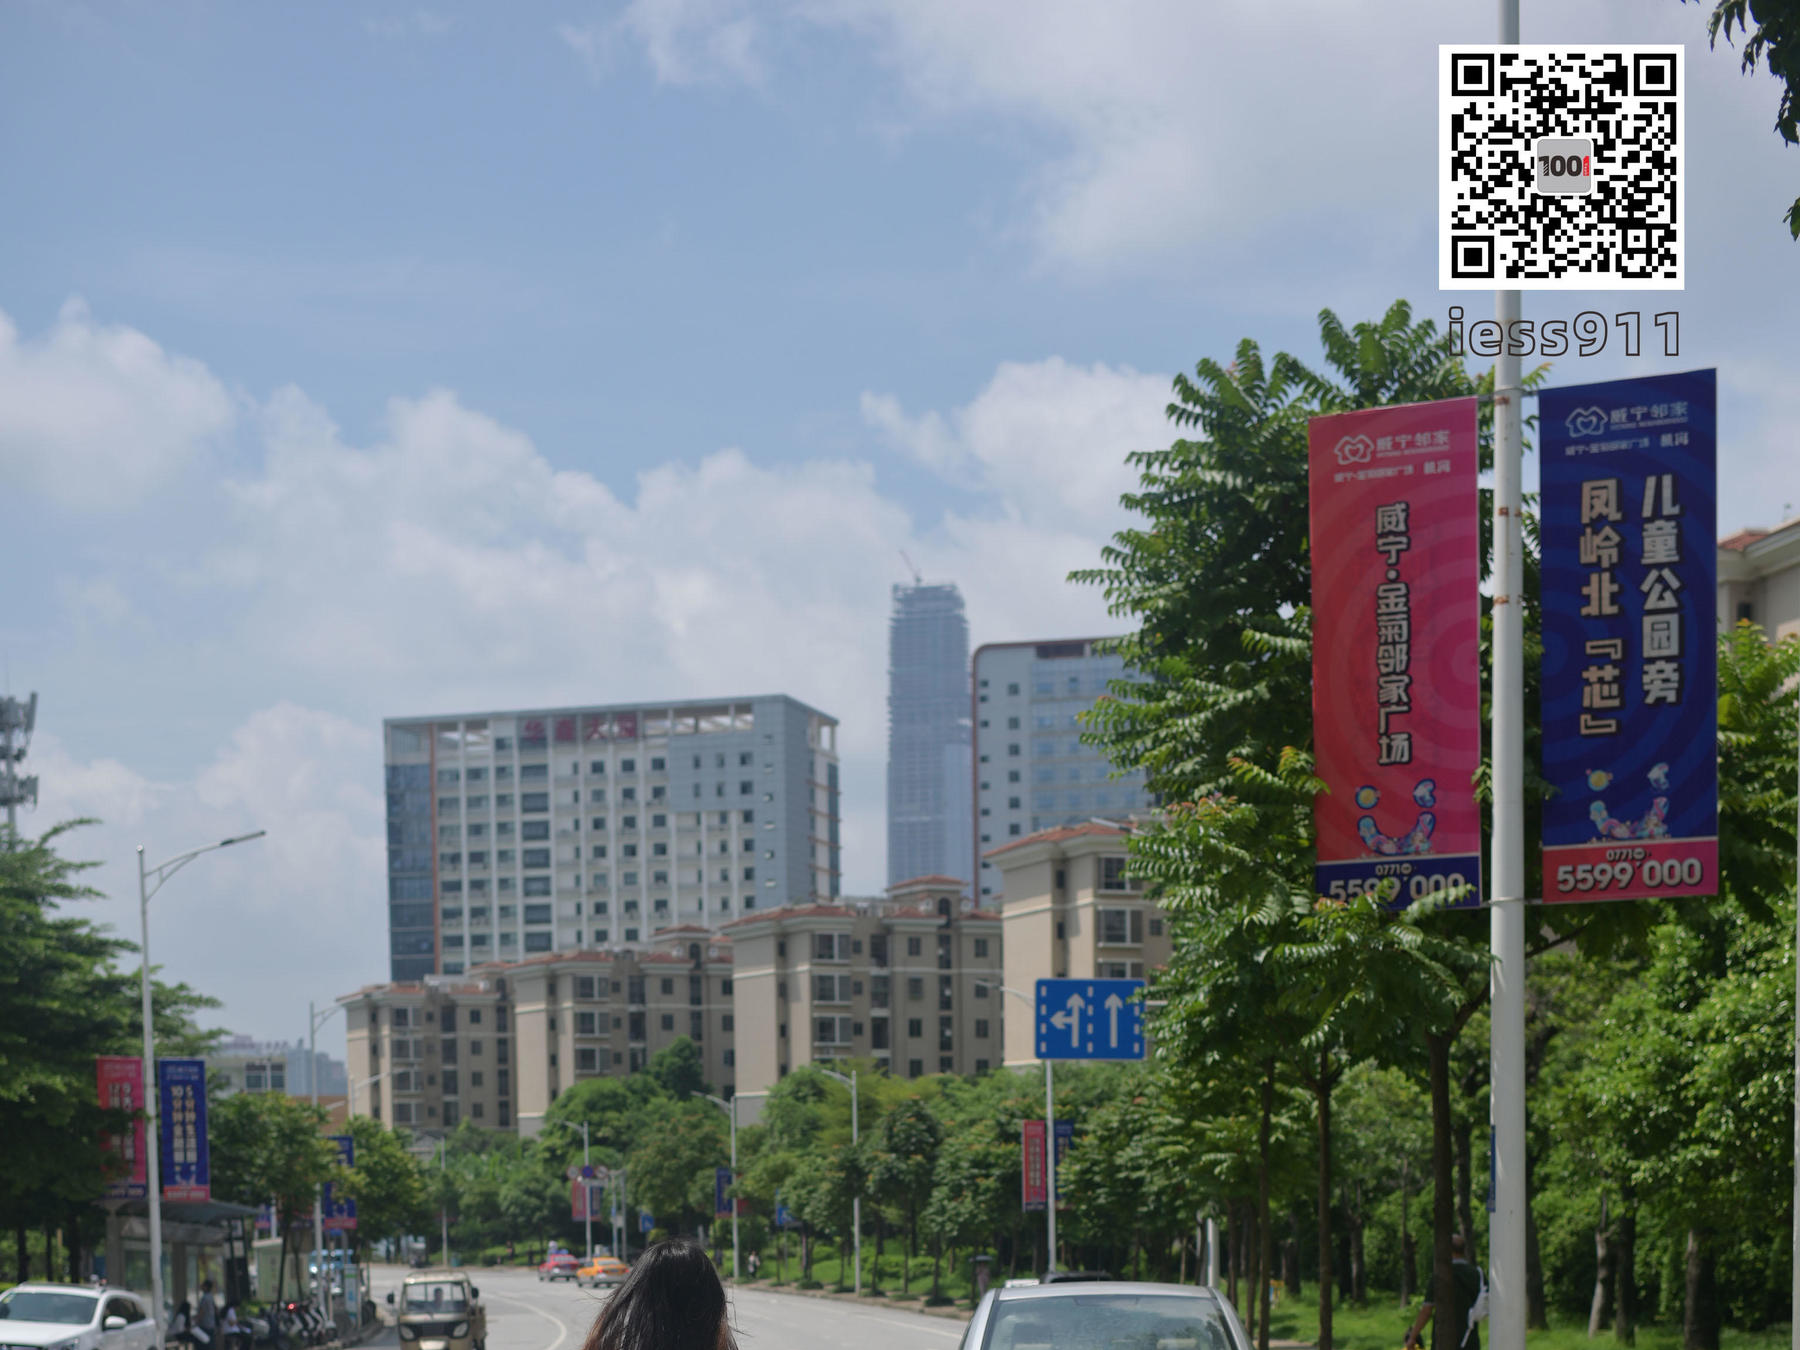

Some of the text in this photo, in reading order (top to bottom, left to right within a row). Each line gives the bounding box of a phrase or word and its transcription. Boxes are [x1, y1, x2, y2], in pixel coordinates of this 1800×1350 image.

[1640, 474, 1682, 705] 儿童公园旁
[1606, 848, 1632, 862] 0771
[1376, 864, 1400, 876] 0771
